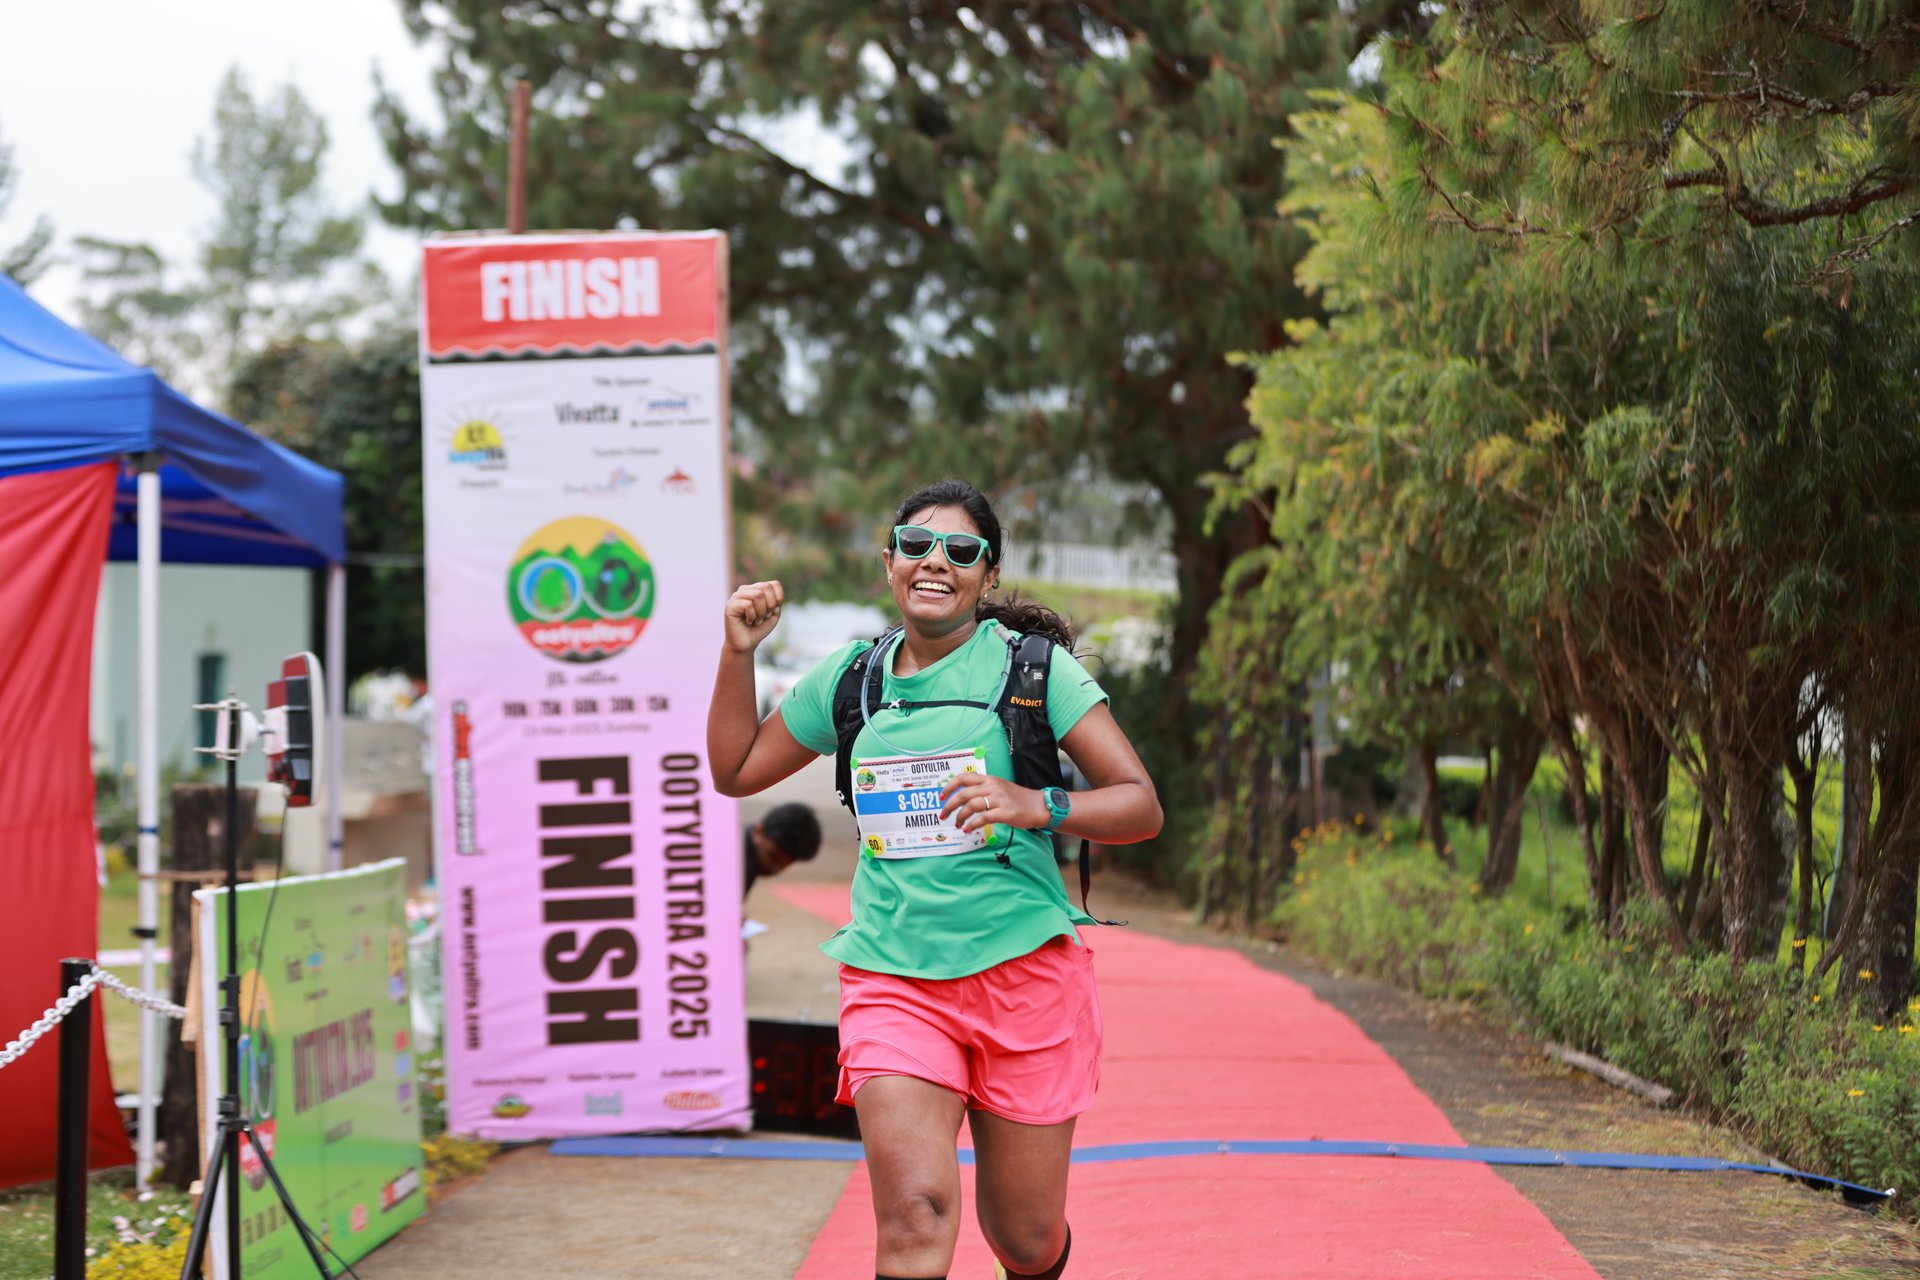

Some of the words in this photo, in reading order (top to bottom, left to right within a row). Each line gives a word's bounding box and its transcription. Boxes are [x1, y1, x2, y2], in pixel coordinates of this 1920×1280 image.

[481, 257, 660, 322] FINISH
[554, 402, 620, 425] Vivatta
[1010, 696, 1043, 707] EVADICT
[911, 761, 950, 774] OOTYULTRA
[898, 790, 940, 811] S-0521
[905, 813, 940, 829] AMRITA
[660, 753, 706, 943] OOTYULTRA
[537, 755, 641, 1046] FINISH
[668, 952, 711, 1040] 2025
